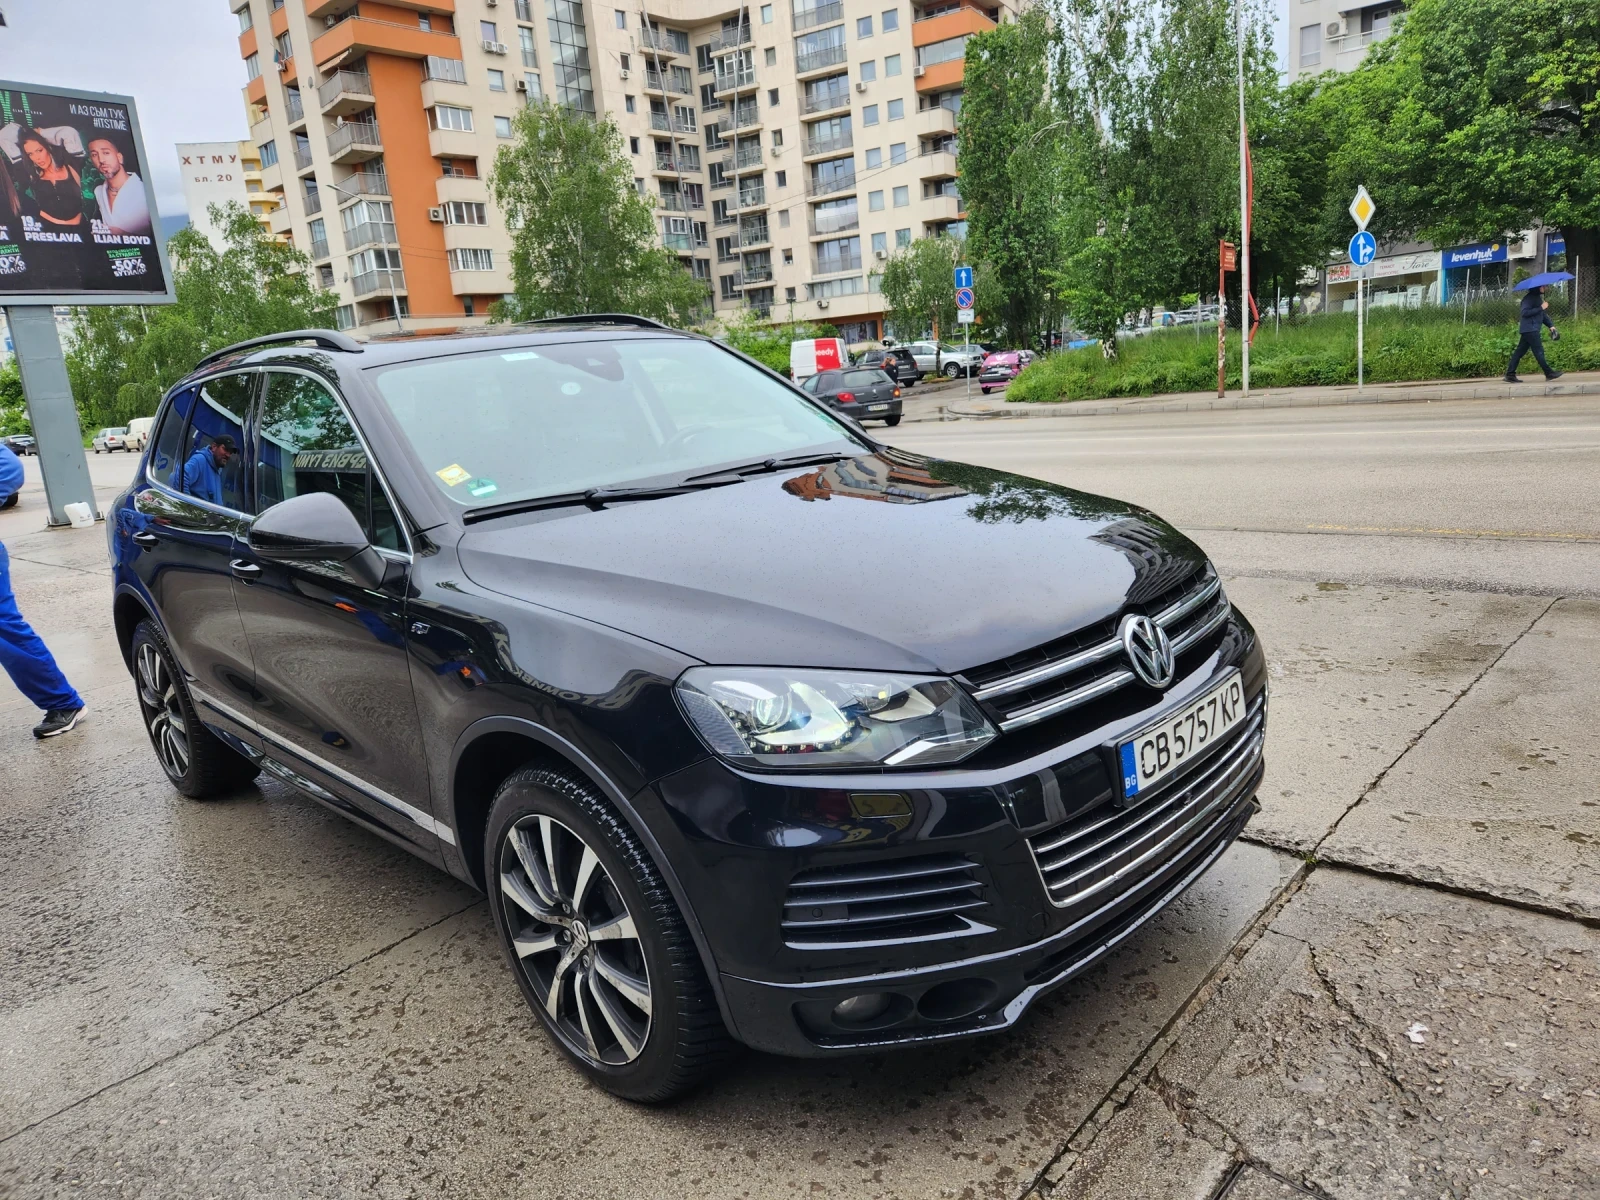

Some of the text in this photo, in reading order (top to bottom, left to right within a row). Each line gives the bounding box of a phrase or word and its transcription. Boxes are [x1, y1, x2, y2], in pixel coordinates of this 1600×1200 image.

[69, 104, 125, 120] И АЗ СЪМ ТУК
[181, 154, 237, 165] ХТМУ
[217, 174, 232, 182] 20
[24, 231, 83, 243] PRESLAVA
[94, 234, 151, 245] ILIAN BOYD
[1451, 247, 1493, 262] levenhuk
[815, 347, 834, 357] eedy
[1173, 697, 1217, 759] 5757
[1220, 681, 1240, 727] KP
[1125, 774, 1136, 789] BG
